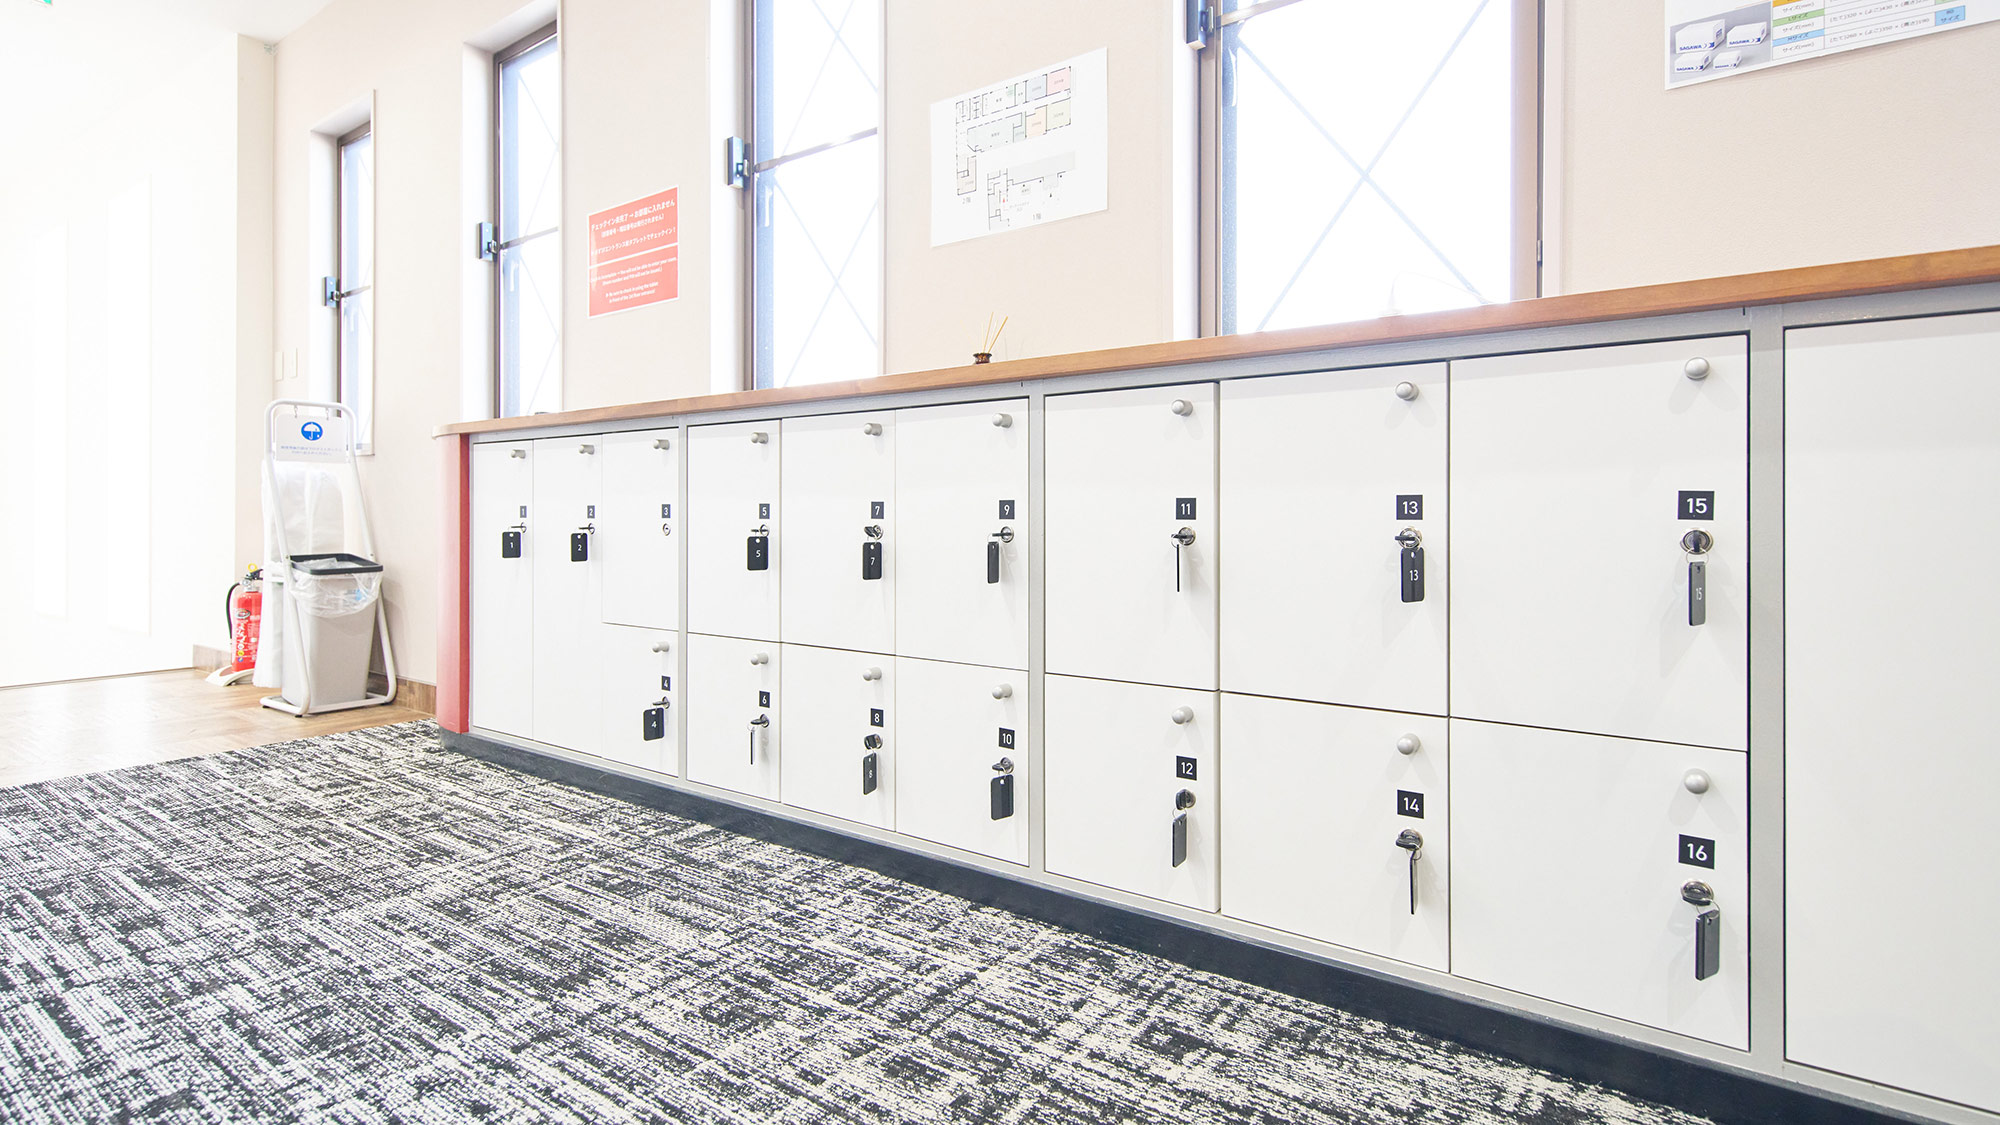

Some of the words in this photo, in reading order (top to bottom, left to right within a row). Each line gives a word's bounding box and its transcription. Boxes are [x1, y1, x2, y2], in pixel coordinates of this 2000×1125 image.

[1729, 38, 1750, 46] SAGAWA
[588, 507, 593, 516] 2
[664, 507, 669, 516] 3
[762, 506, 767, 516] 5
[873, 504, 880, 517] 7
[1003, 504, 1010, 516] 9
[1180, 502, 1190, 516] 11
[1402, 500, 1418, 515] 13
[1686, 497, 1708, 514] 15
[577, 544, 582, 552] 2
[755, 549, 761, 558] 5
[870, 556, 876, 566] 7
[1408, 568, 1419, 582] 13
[1694, 586, 1703, 601] 15
[663, 679, 669, 688] 4
[761, 694, 767, 705] 6
[874, 712, 880, 724] 8
[650, 720, 657, 729] 4
[1002, 732, 1013, 745] 10
[1180, 761, 1194, 776] 12
[1403, 796, 1421, 814] 14
[1686, 842, 1708, 862] 16
